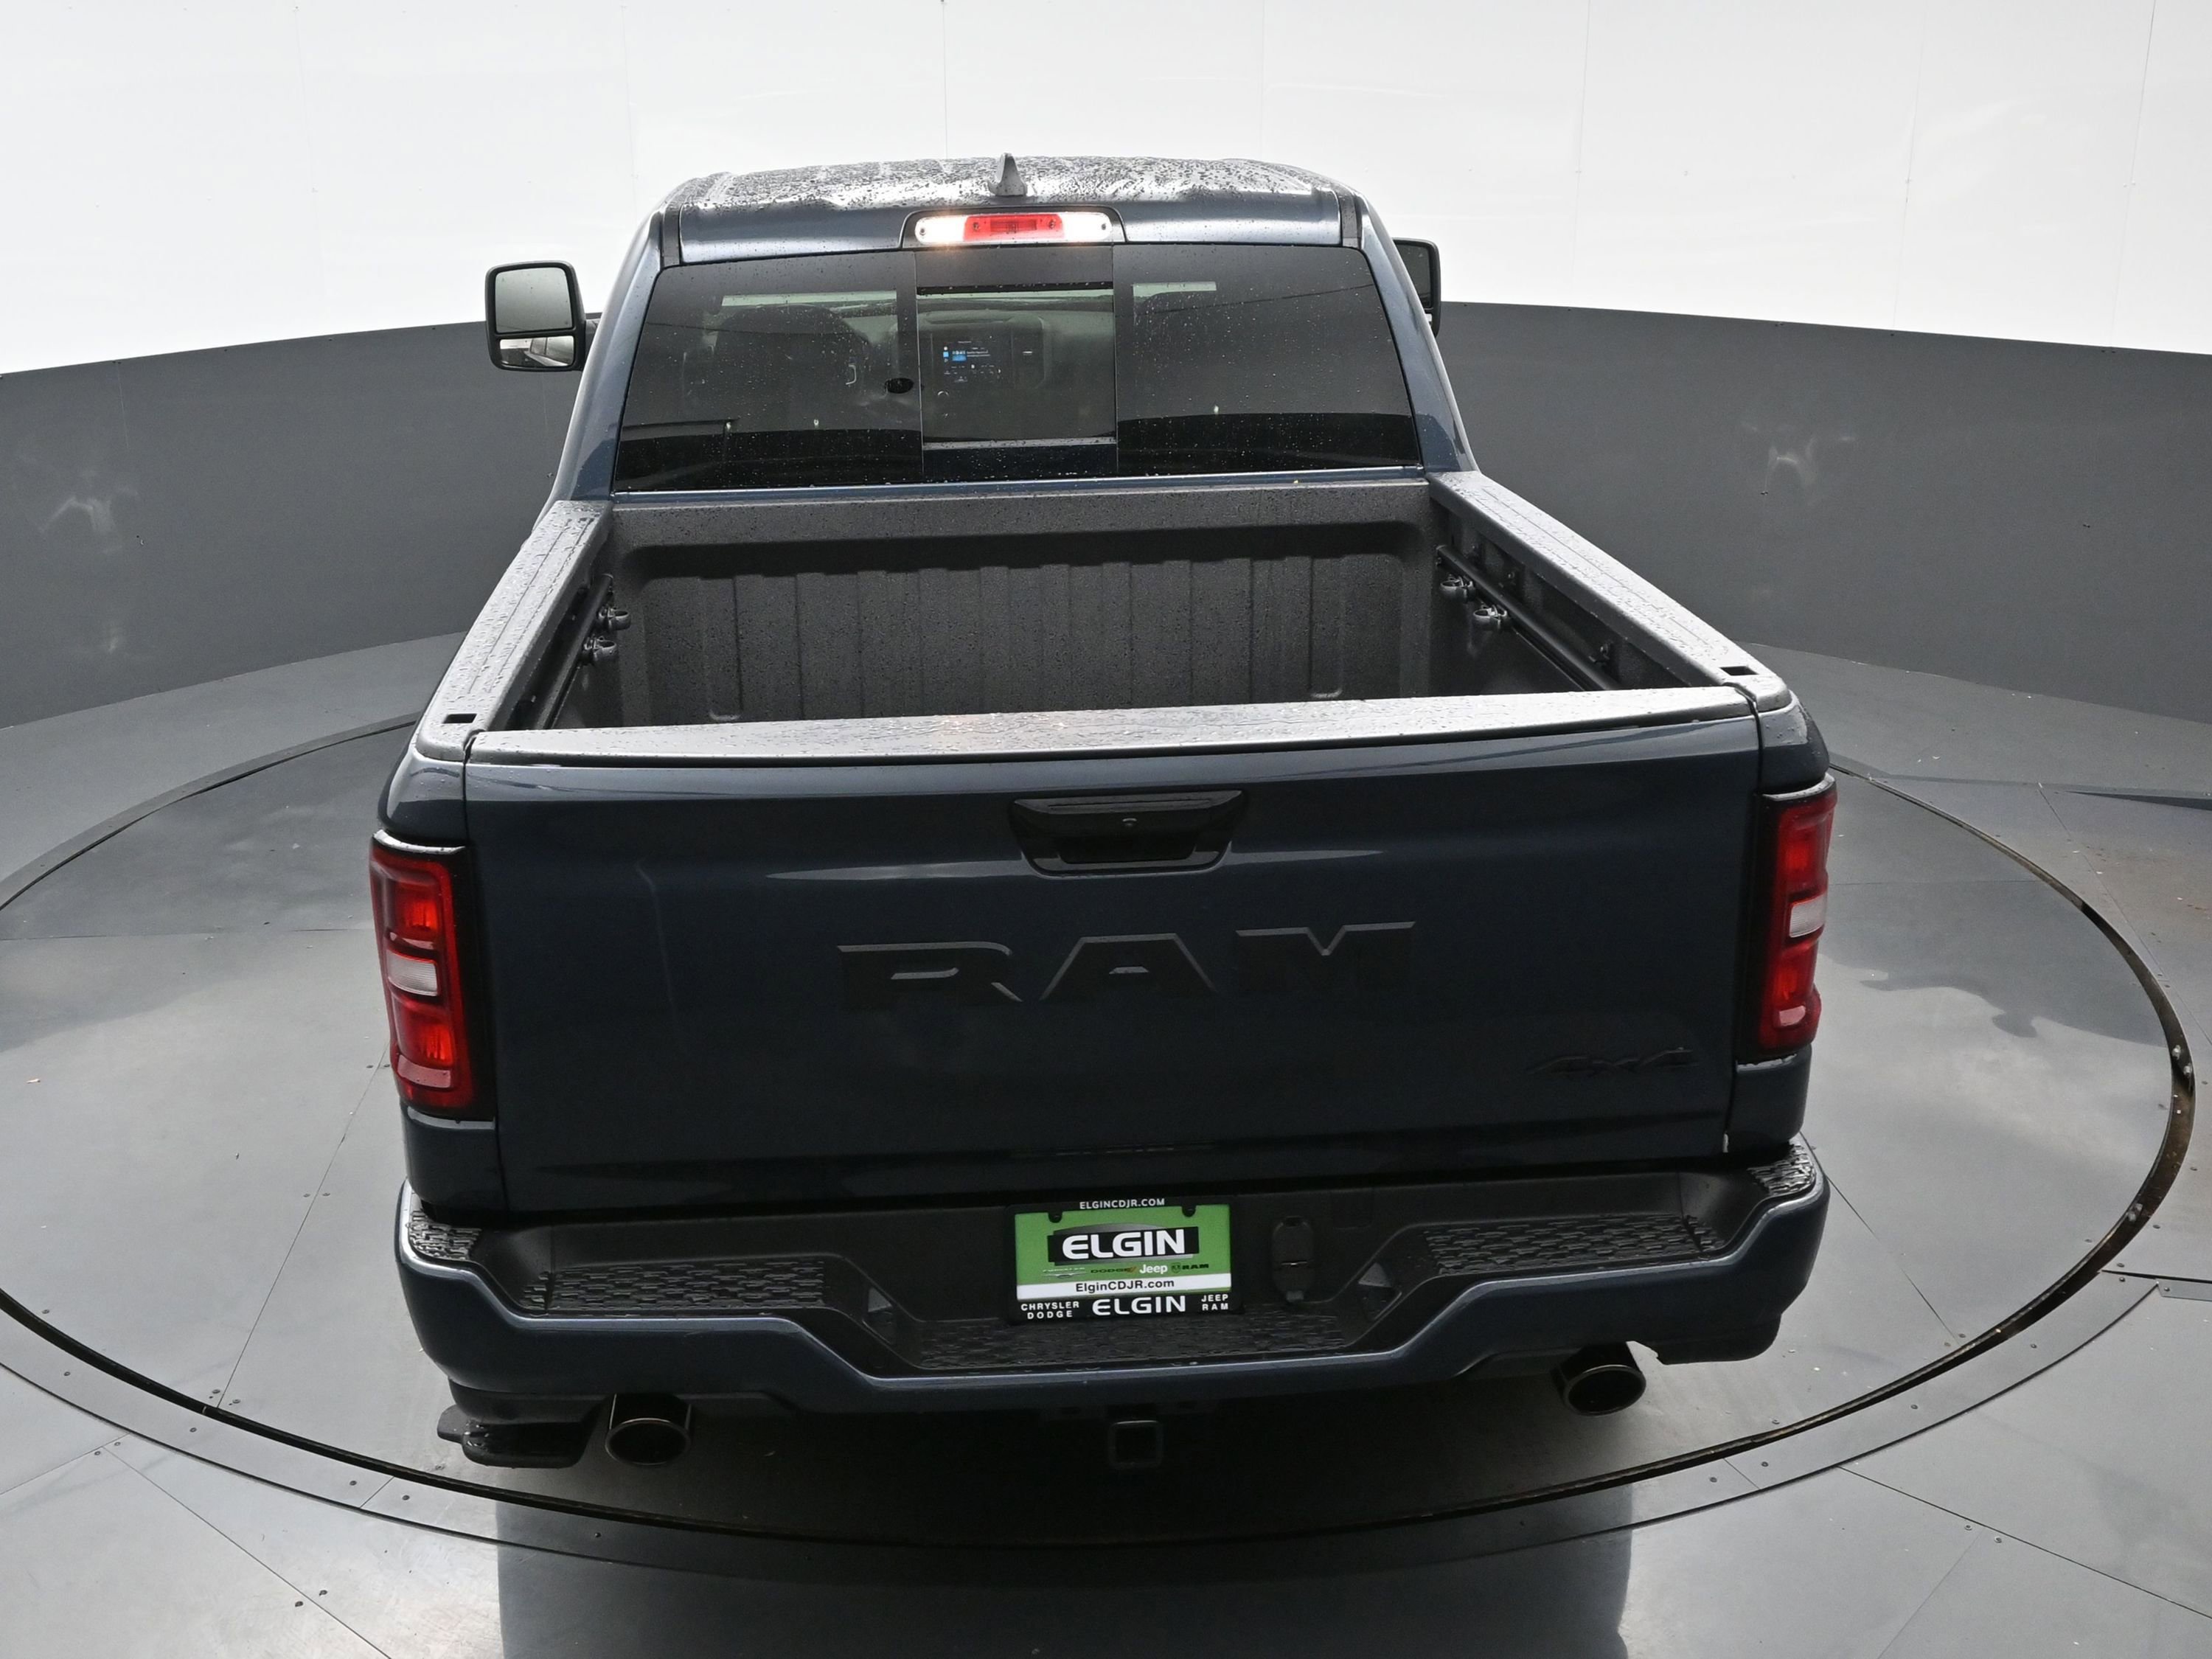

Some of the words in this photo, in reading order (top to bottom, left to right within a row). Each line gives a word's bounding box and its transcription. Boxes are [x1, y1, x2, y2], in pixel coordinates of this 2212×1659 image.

[837, 921, 1416, 1010] RAM
[1079, 1198, 1165, 1209] ELGINCDJR.COM
[1062, 1228, 1185, 1259] ELGIN
[1139, 1265, 1168, 1274] Jeep
[1076, 1279, 1175, 1294] ElginCDJR.com
[1201, 1294, 1229, 1303] JEEP
[1020, 1301, 1079, 1312] CHRYSLER
[1092, 1295, 1186, 1316] ELGIN
[1202, 1303, 1229, 1311] RAM
[1027, 1310, 1073, 1319] DODGE
